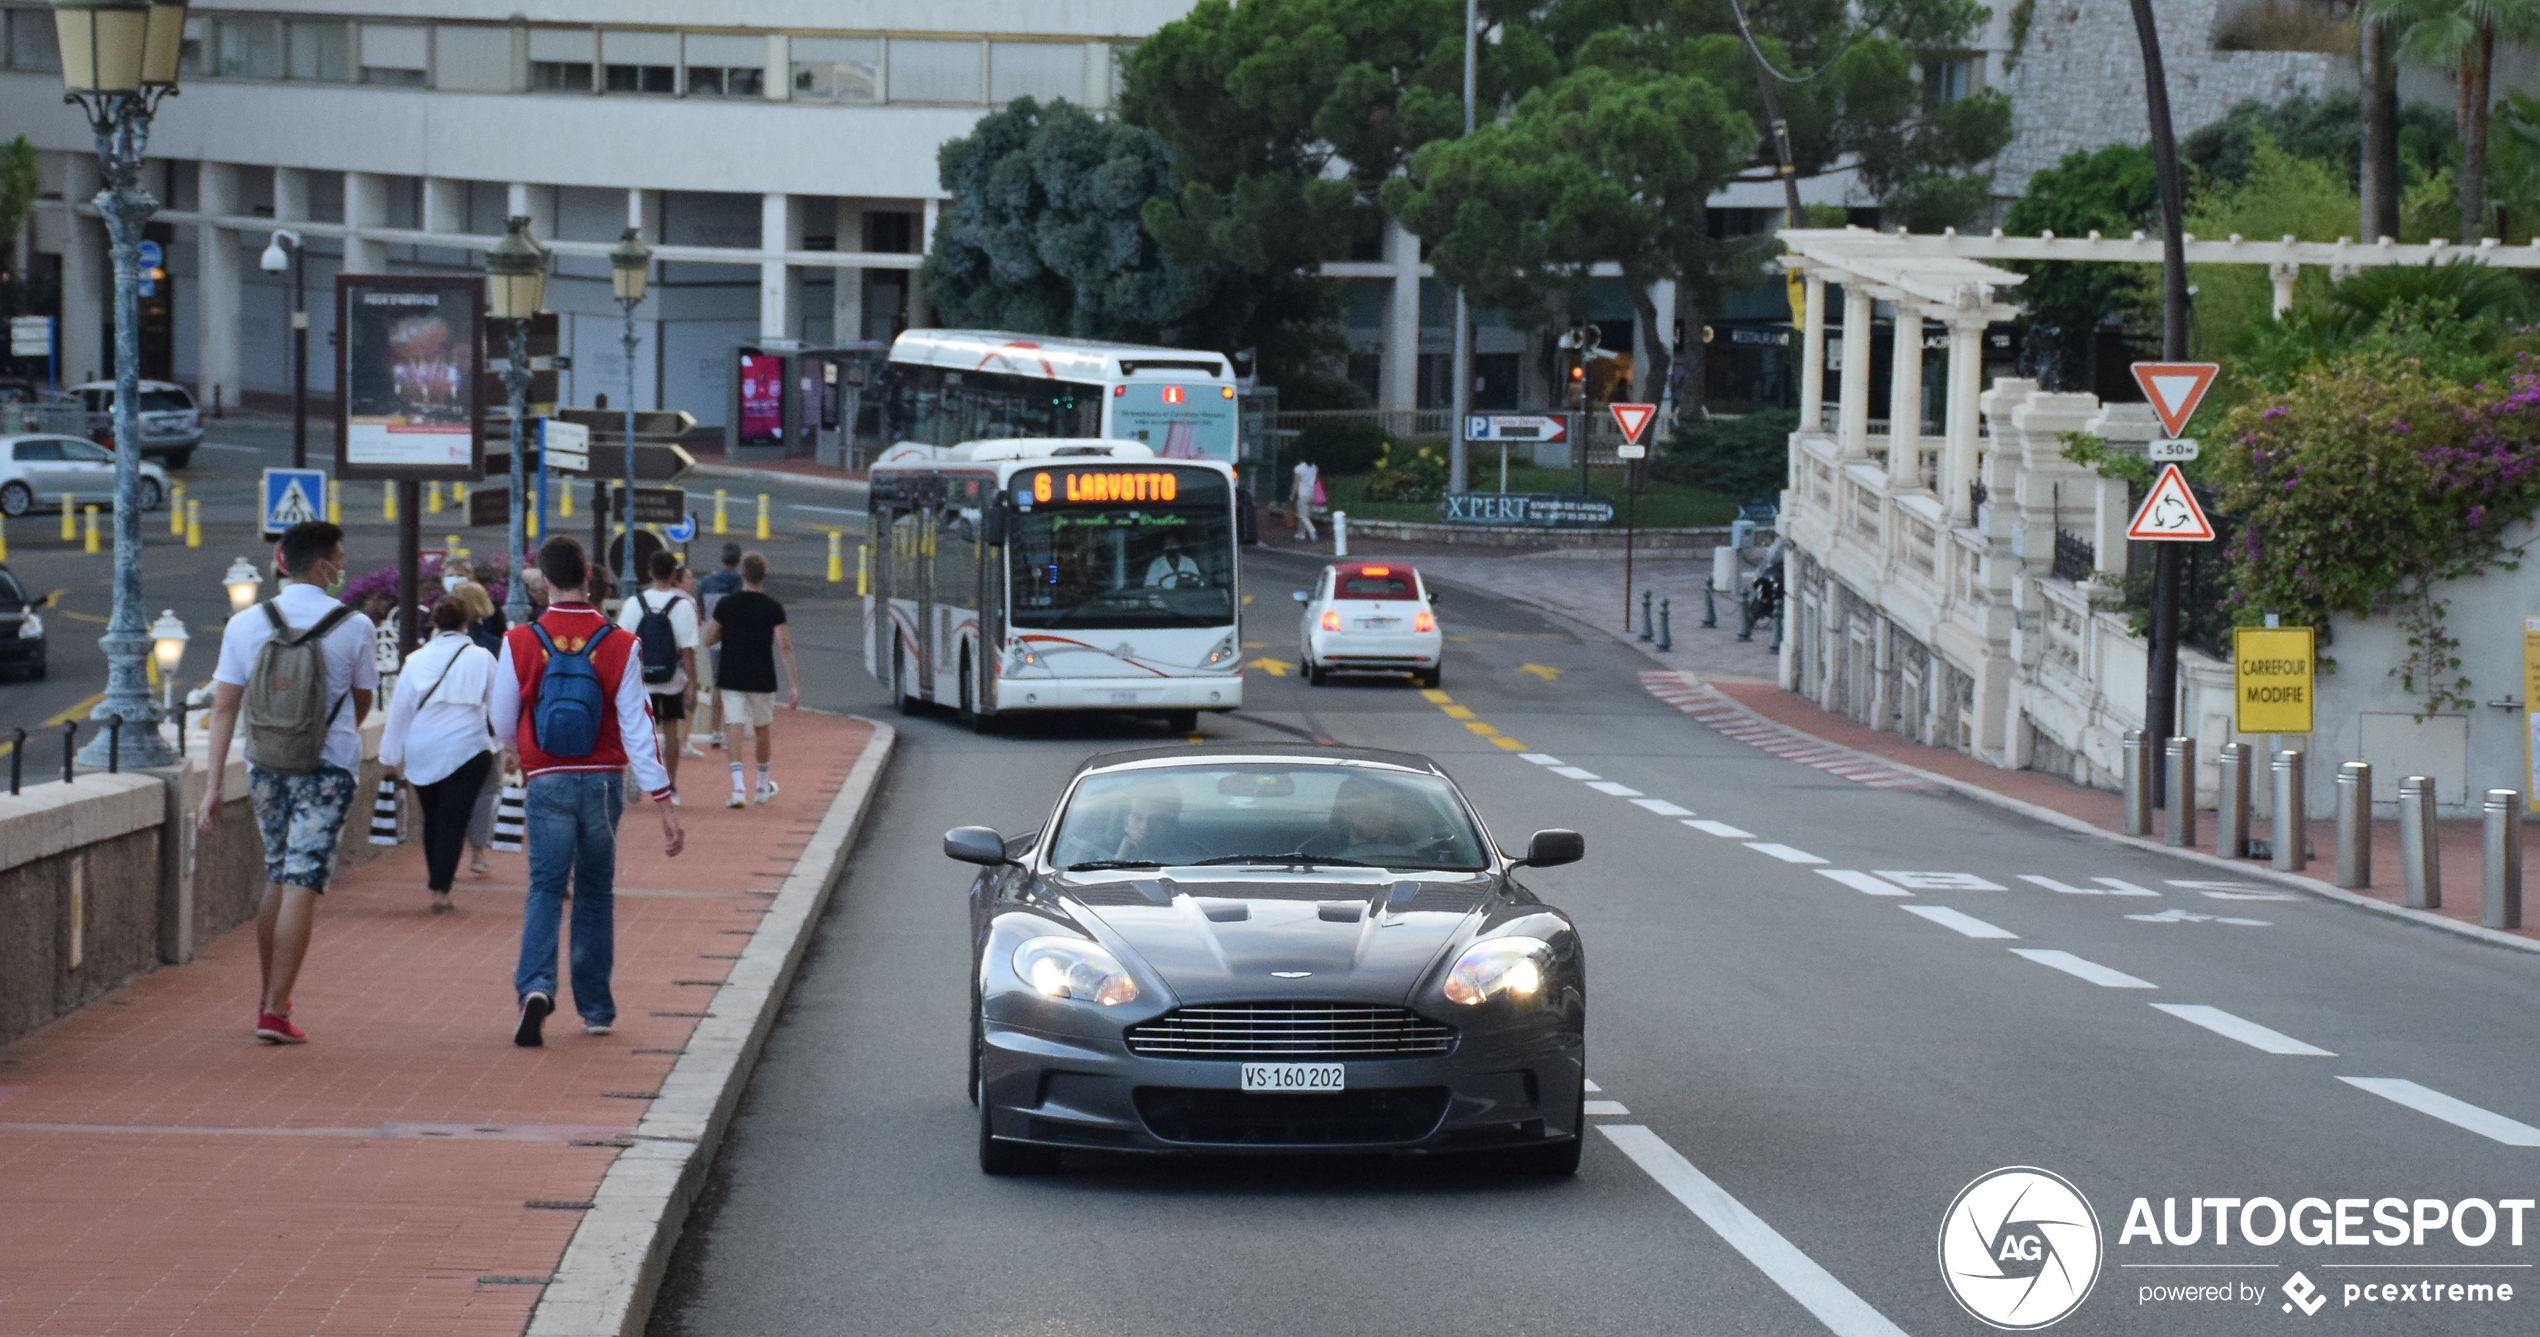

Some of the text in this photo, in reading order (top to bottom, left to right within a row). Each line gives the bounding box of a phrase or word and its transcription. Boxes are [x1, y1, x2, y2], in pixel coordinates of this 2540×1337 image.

[1471, 416, 1487, 437] P
[1034, 472, 1176, 502] 6 LARVOTTO
[1447, 495, 1530, 519] X'PERT
[2242, 659, 2307, 676] CARREFOUR
[2247, 686, 2304, 703] MODIFIE
[1870, 869, 2303, 901] BUS
[1309, 1067, 1343, 1087] 202
